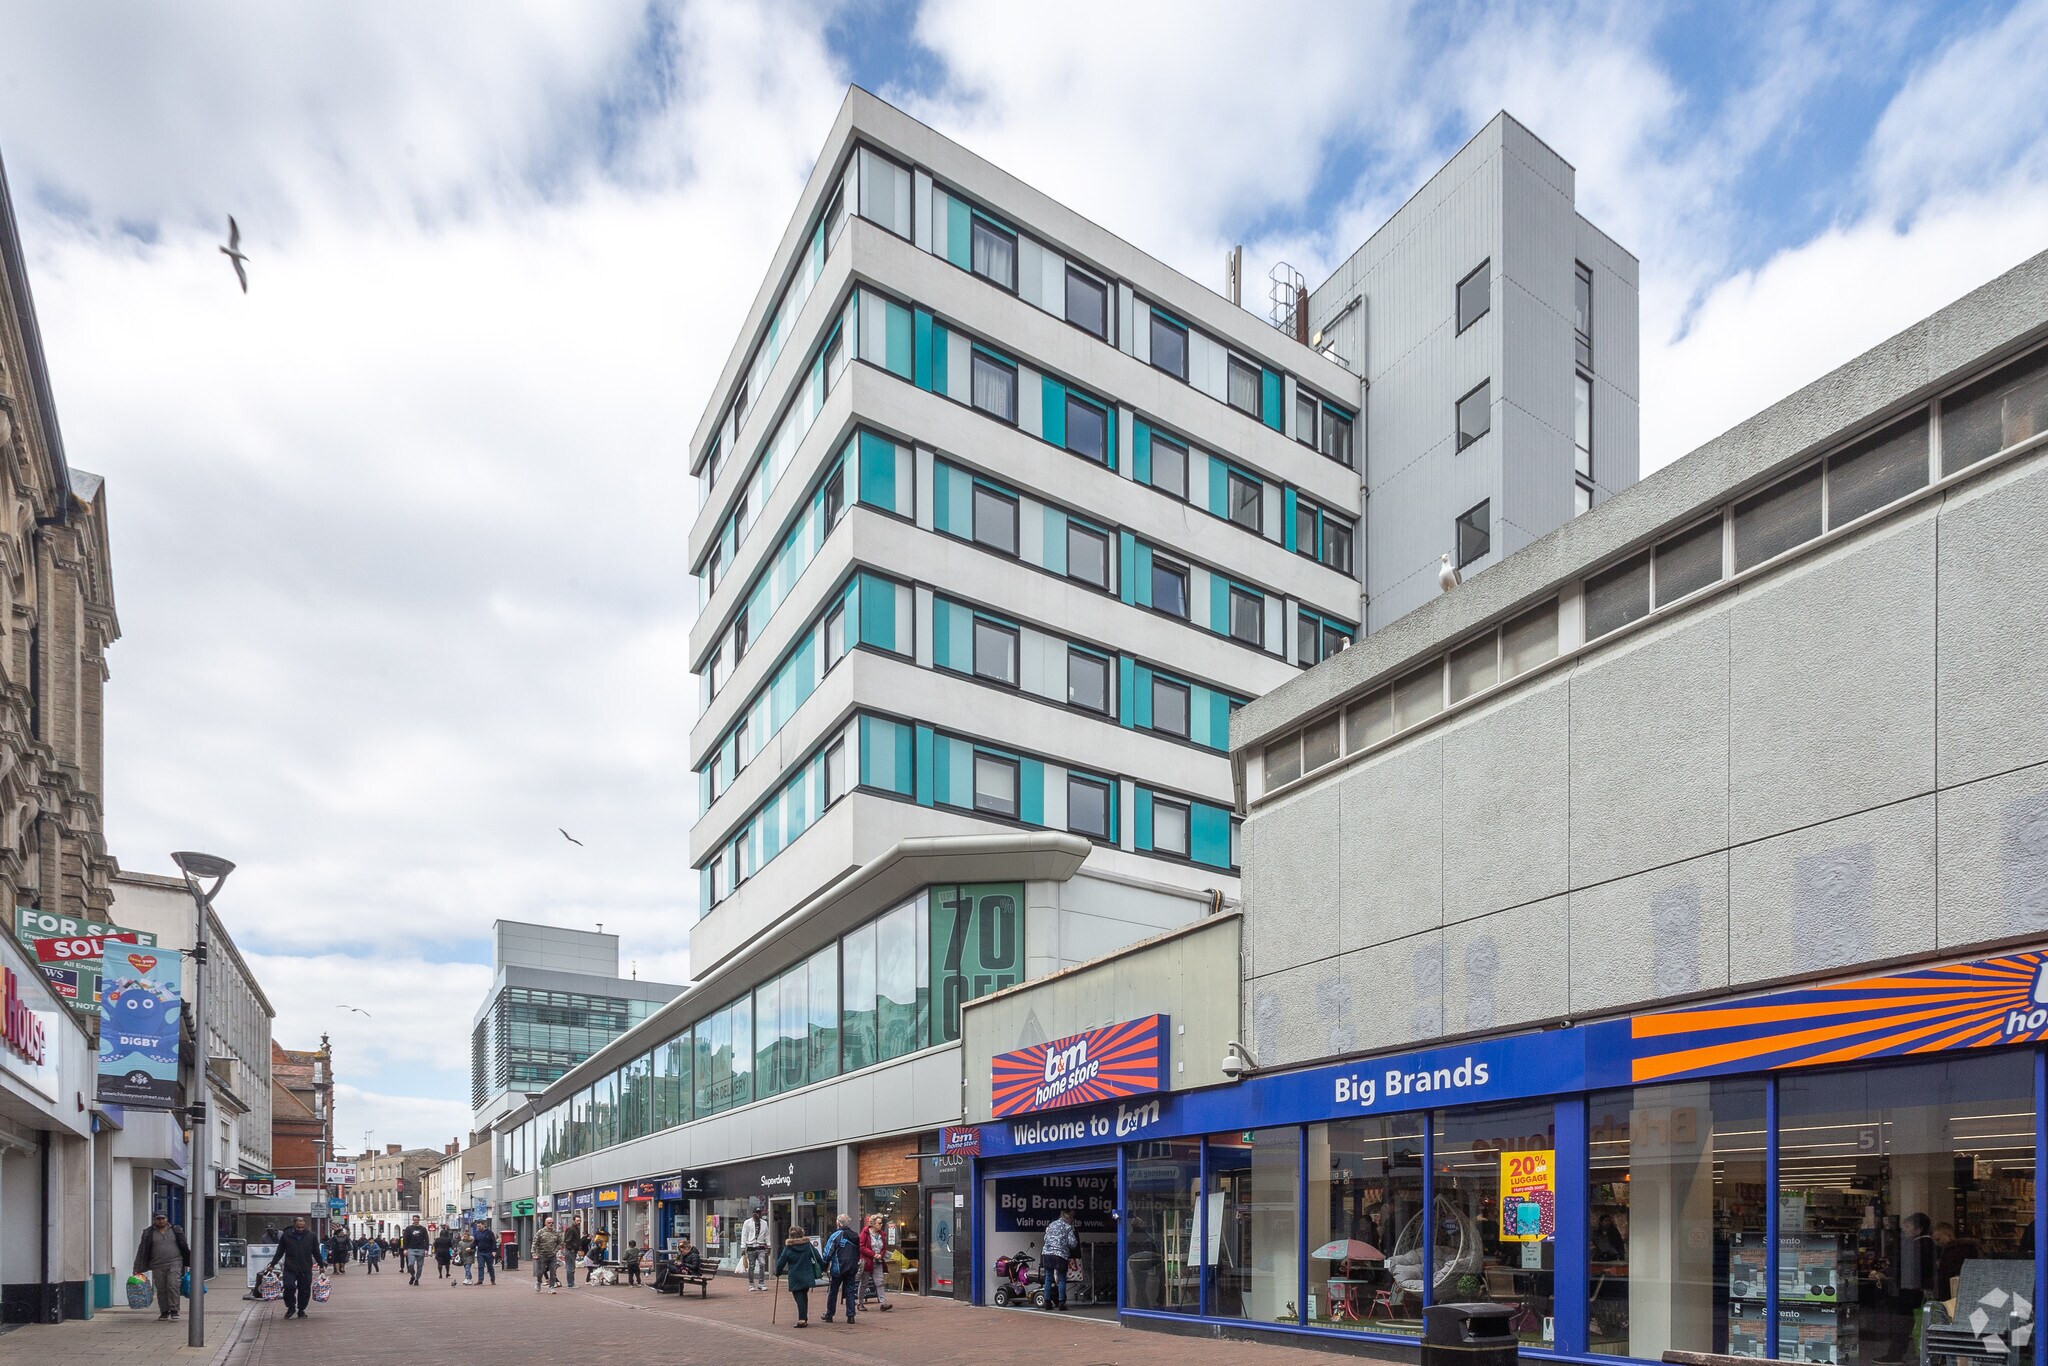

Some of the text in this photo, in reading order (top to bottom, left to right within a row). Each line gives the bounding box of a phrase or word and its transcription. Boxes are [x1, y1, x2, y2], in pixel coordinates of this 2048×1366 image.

[22, 910, 153, 947] FOR SE
[2005, 1008, 2048, 1035] ho
[120, 1036, 158, 1047] DiGBY
[1044, 1040, 1087, 1082] b&m
[1035, 1059, 1099, 1106] home store
[1335, 1057, 1489, 1107] Big Brands
[1013, 1100, 1160, 1146] Welcome to b&m
[946, 1142, 963, 1150] home
[1859, 1130, 1875, 1149] 5
[1509, 1155, 1546, 1177] 20%
[761, 1174, 792, 1188] Superdrug
[1077, 1178, 1108, 1192] way
[1511, 1174, 1547, 1185] LUGGAGE
[1001, 1193, 1171, 1216] Big Brands Big avings
[1016, 1217, 1034, 1228] Visit
[1036, 1219, 1049, 1227] our
[938, 1227, 946, 1242] 45
